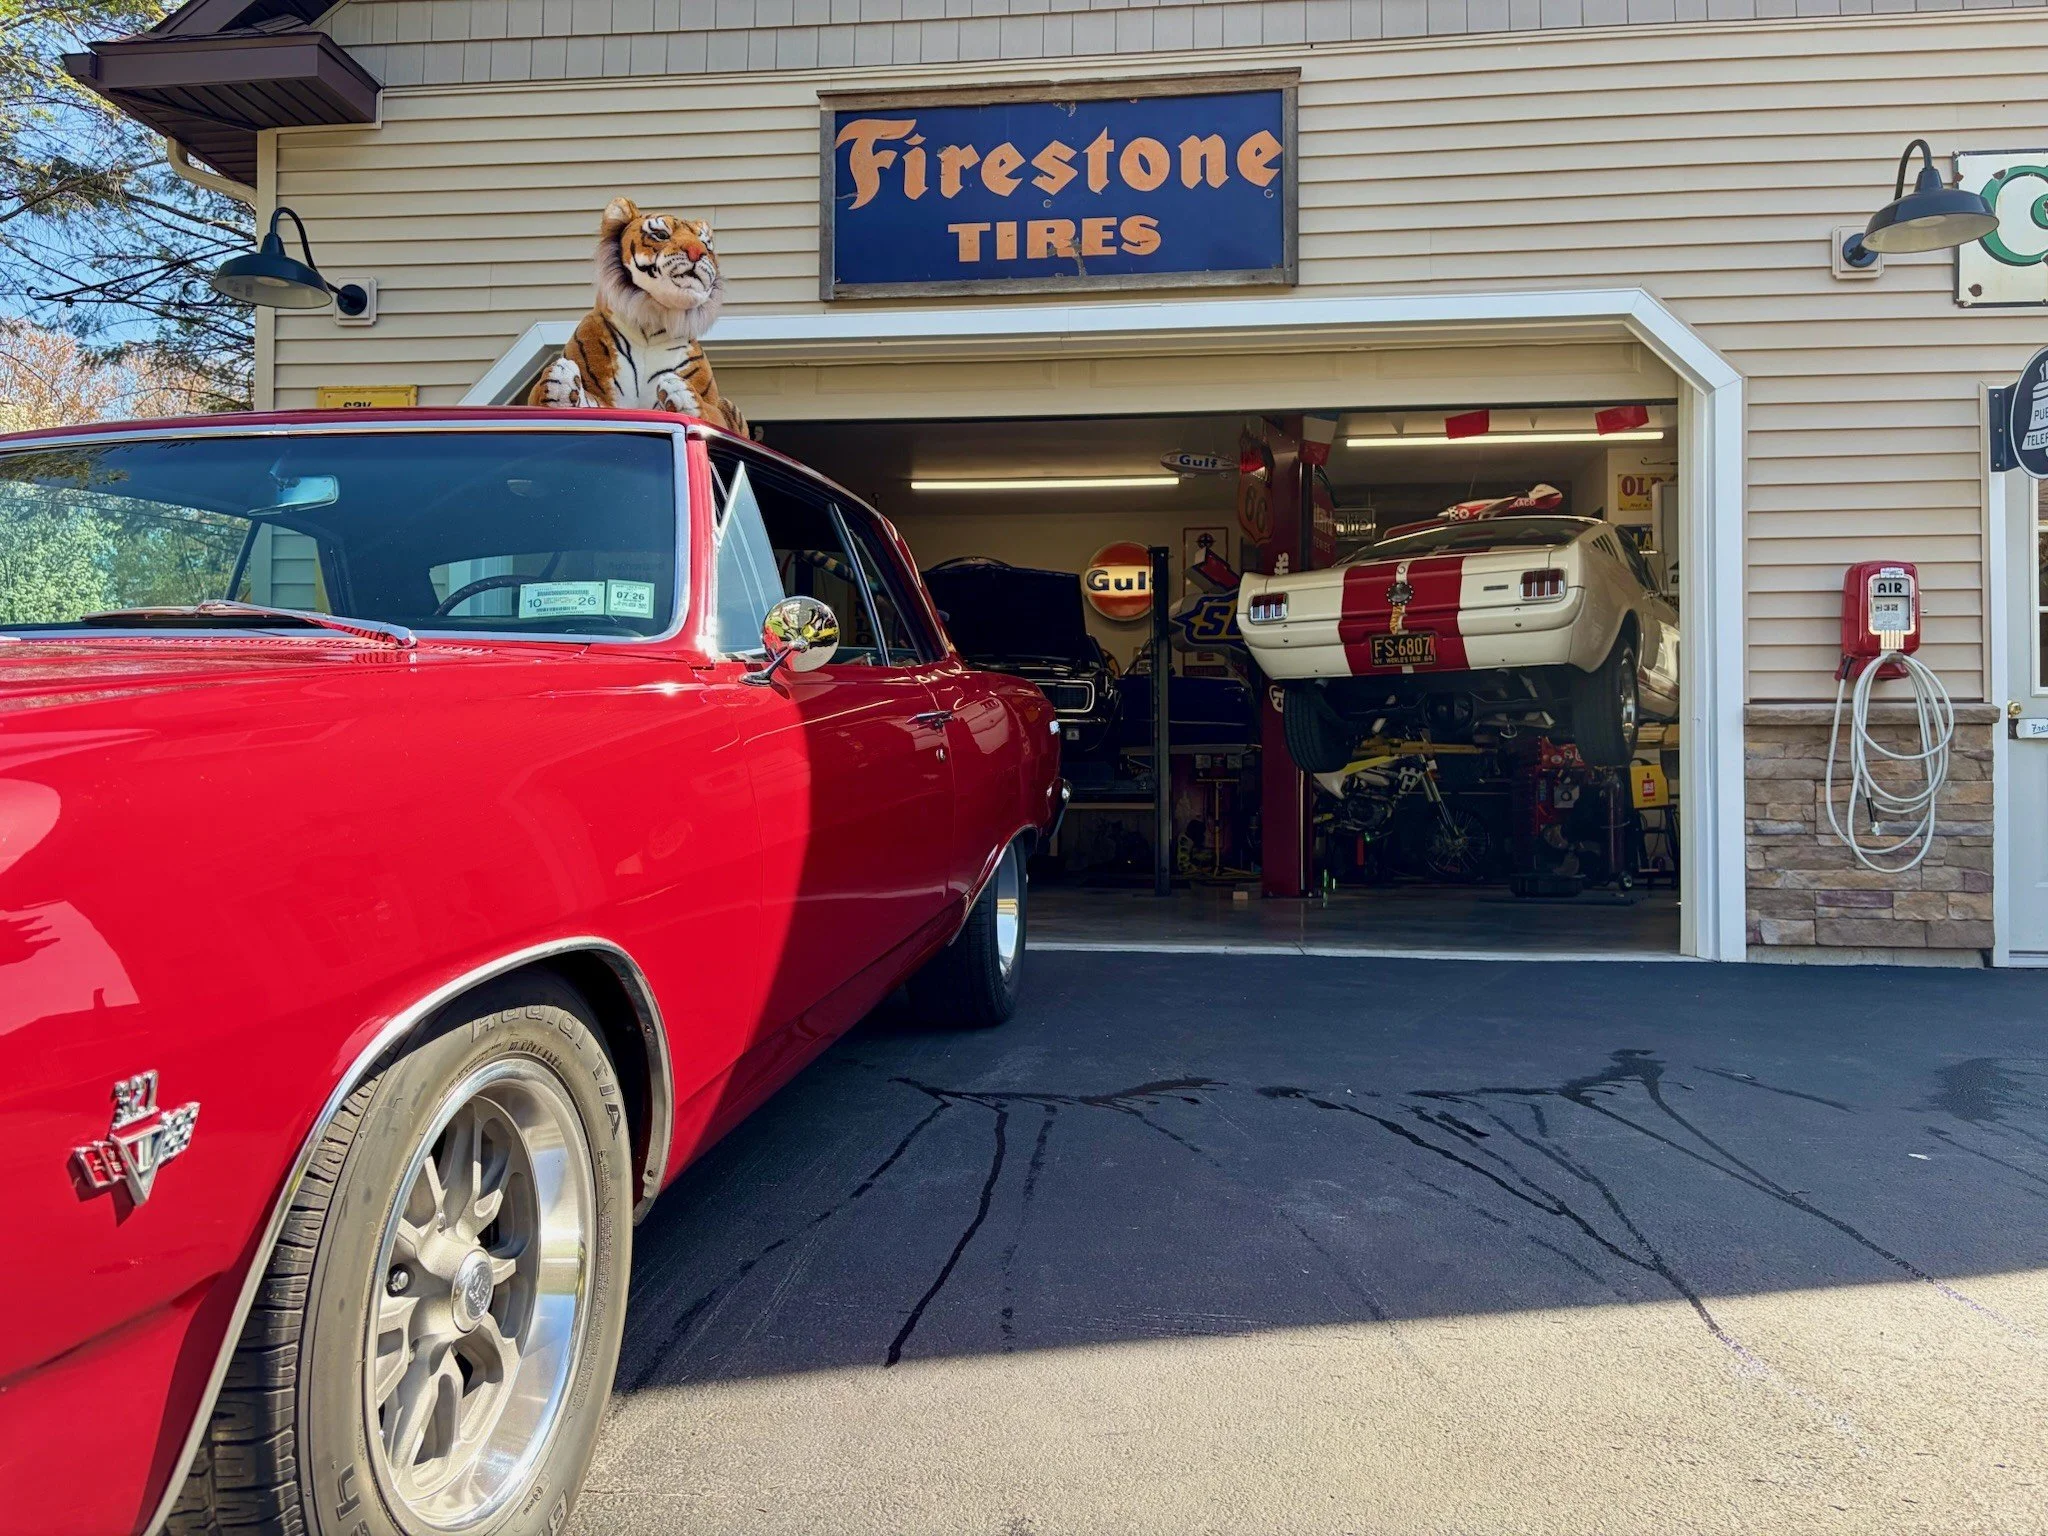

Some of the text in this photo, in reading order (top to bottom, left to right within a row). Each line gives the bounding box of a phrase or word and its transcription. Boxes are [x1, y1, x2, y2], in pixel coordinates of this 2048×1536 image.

[835, 118, 1284, 211] Firestone
[948, 215, 1161, 263] TIRES
[1179, 455, 1218, 468] Gulf
[1878, 582, 1902, 593] AIR
[527, 596, 597, 608] 10 26
[616, 591, 645, 601] 07 26
